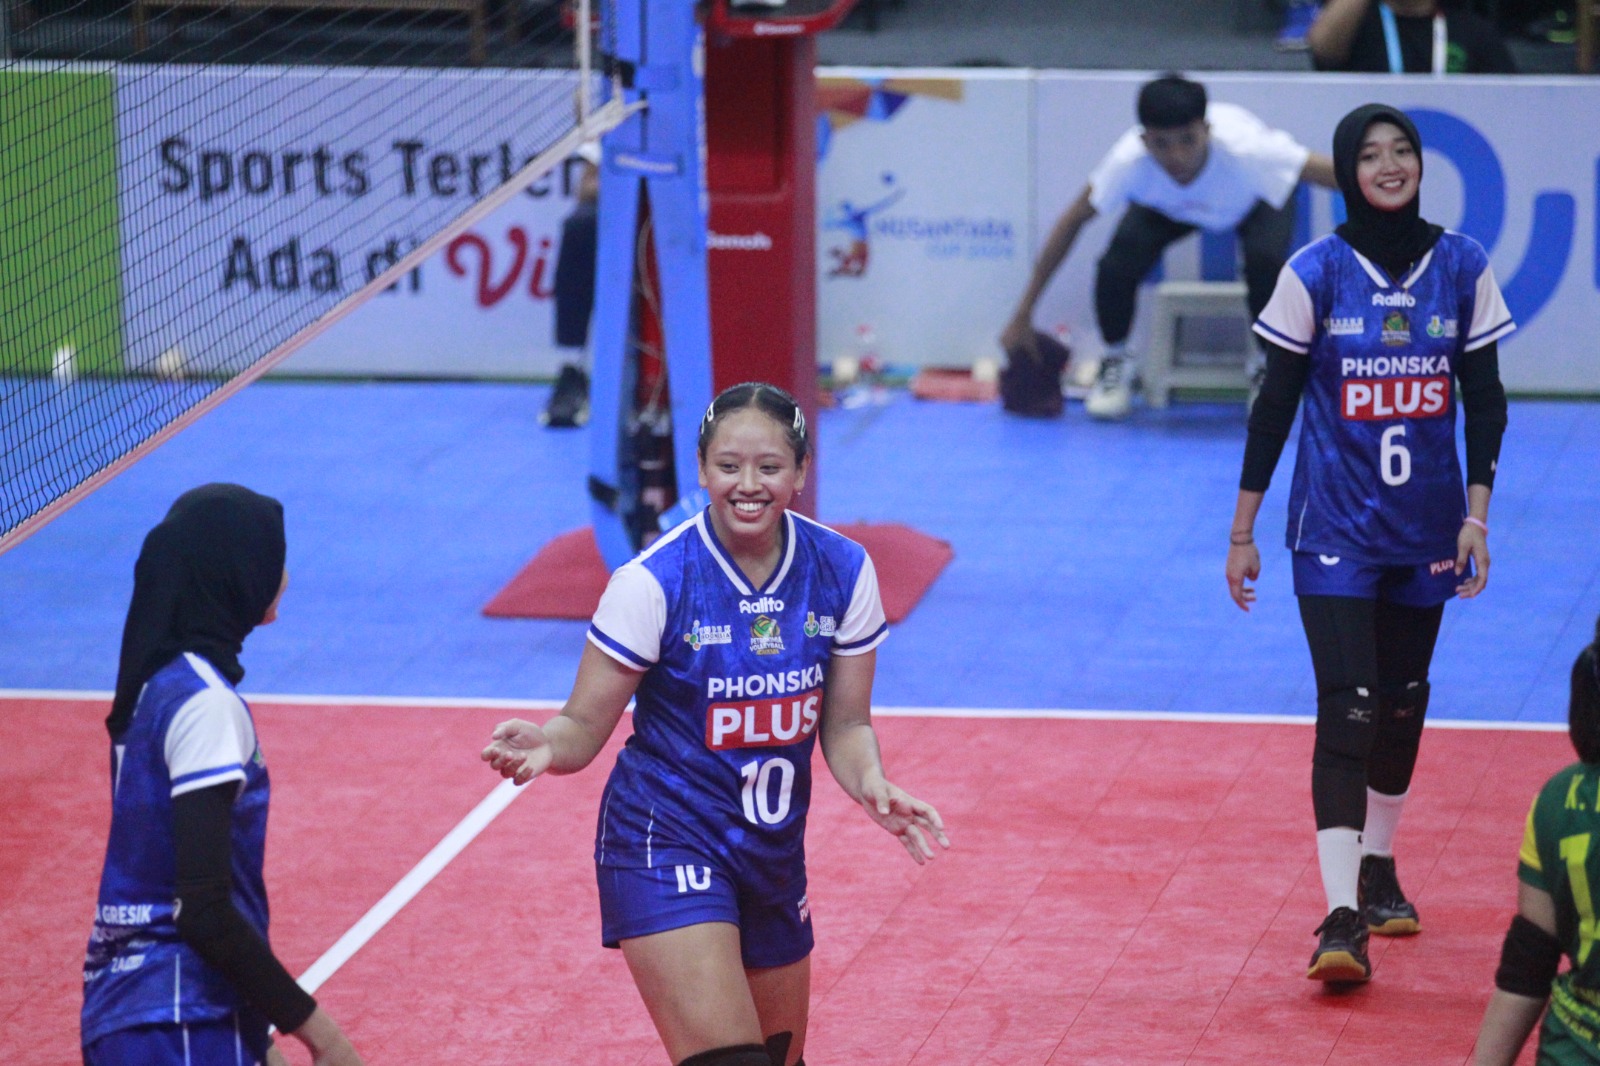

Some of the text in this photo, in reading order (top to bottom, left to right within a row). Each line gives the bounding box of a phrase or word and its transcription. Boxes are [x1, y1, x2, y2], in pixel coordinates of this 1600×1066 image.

[161, 136, 369, 202] Sports
[223, 236, 342, 293] Ada
[365, 237, 422, 292] di
[1341, 355, 1450, 377] PHONSKA
[1345, 380, 1444, 416] PLUS
[1379, 424, 1412, 487] 6
[707, 663, 824, 698] PHONSKA
[711, 695, 819, 746] PLUS
[740, 757, 796, 825] 10
[101, 903, 154, 925] GRESIK
